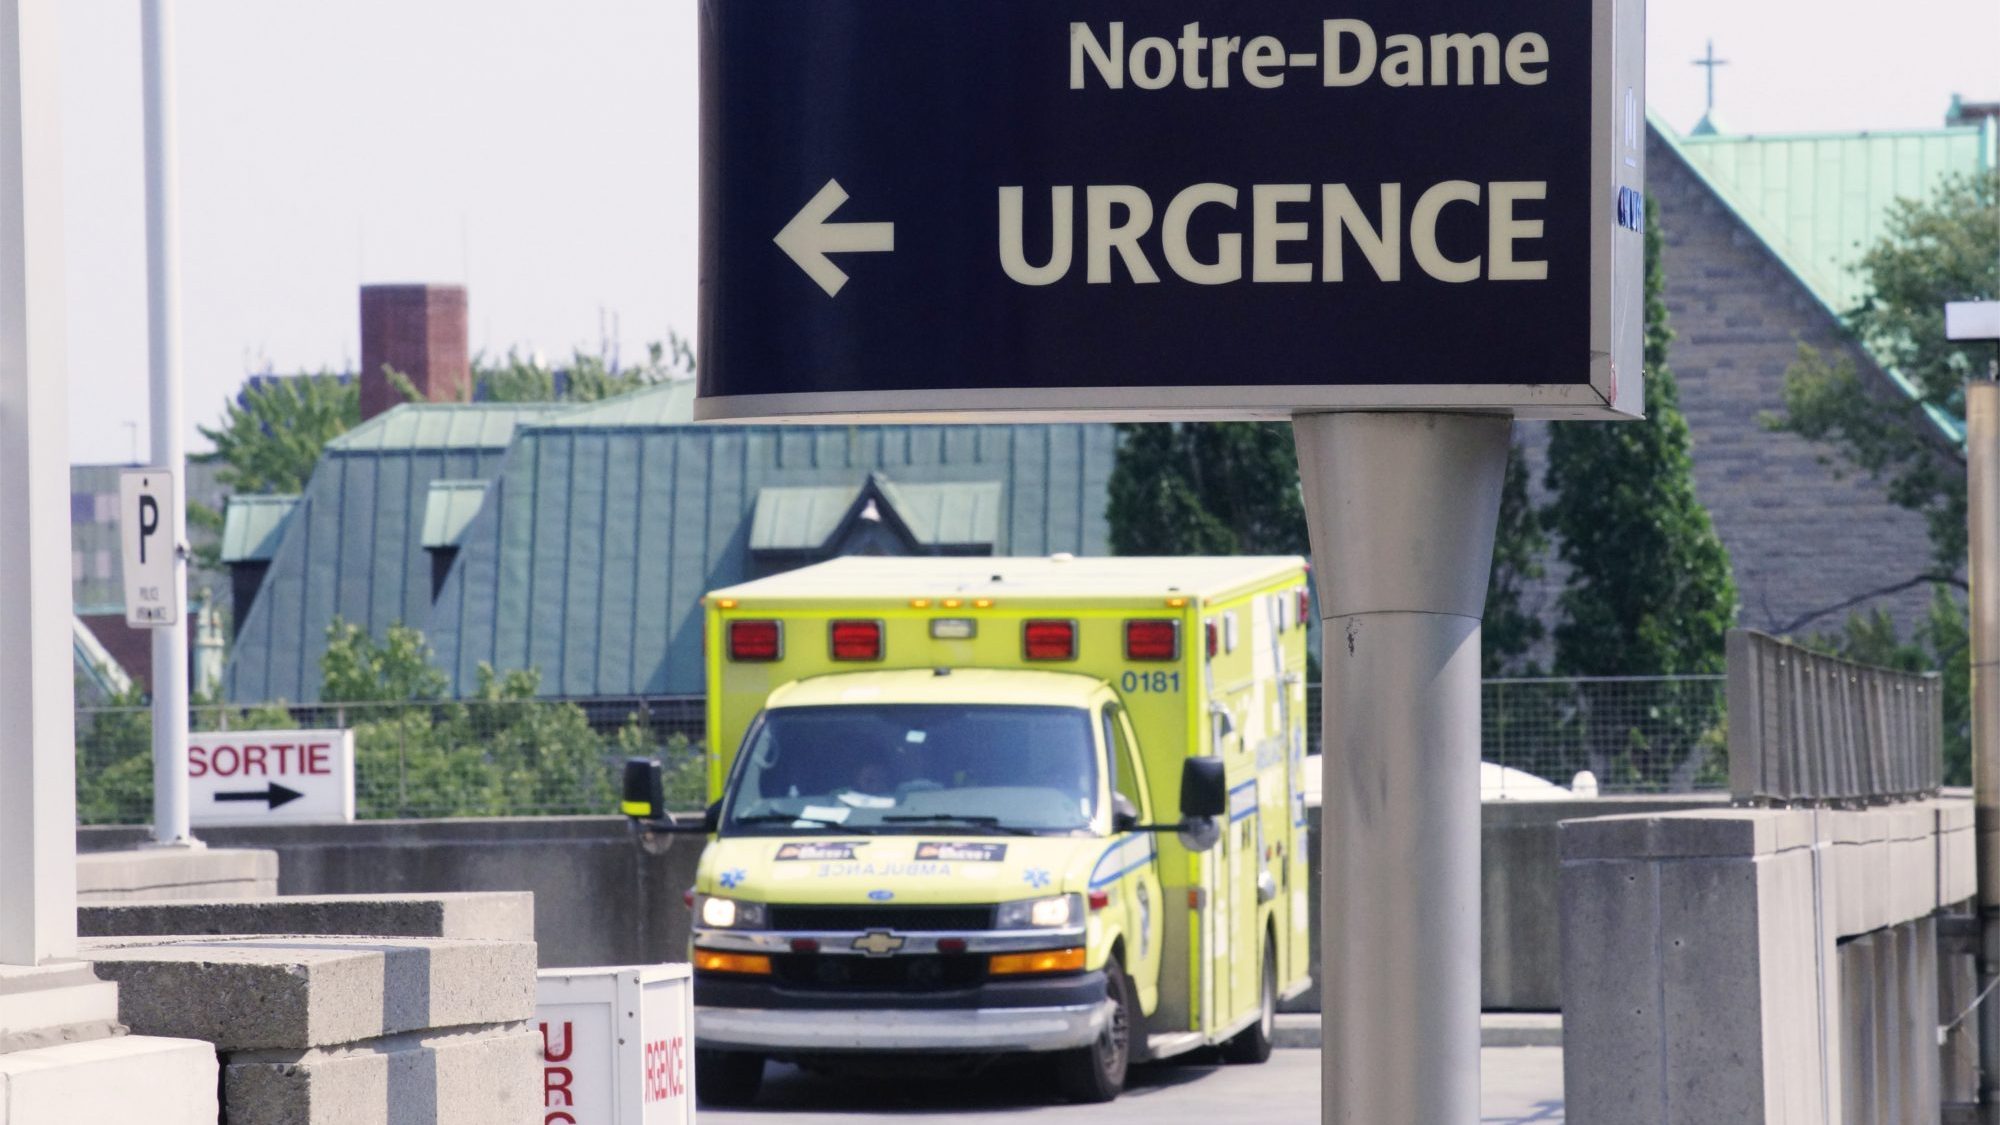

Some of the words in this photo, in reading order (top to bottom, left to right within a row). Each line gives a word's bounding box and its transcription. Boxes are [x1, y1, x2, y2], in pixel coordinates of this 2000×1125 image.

[1069, 18, 1549, 90] Notre-Dame
[998, 180, 1548, 286] URGENCE
[139, 495, 159, 564] P
[1121, 670, 1179, 692] 0181
[188, 743, 331, 777] SORTIE
